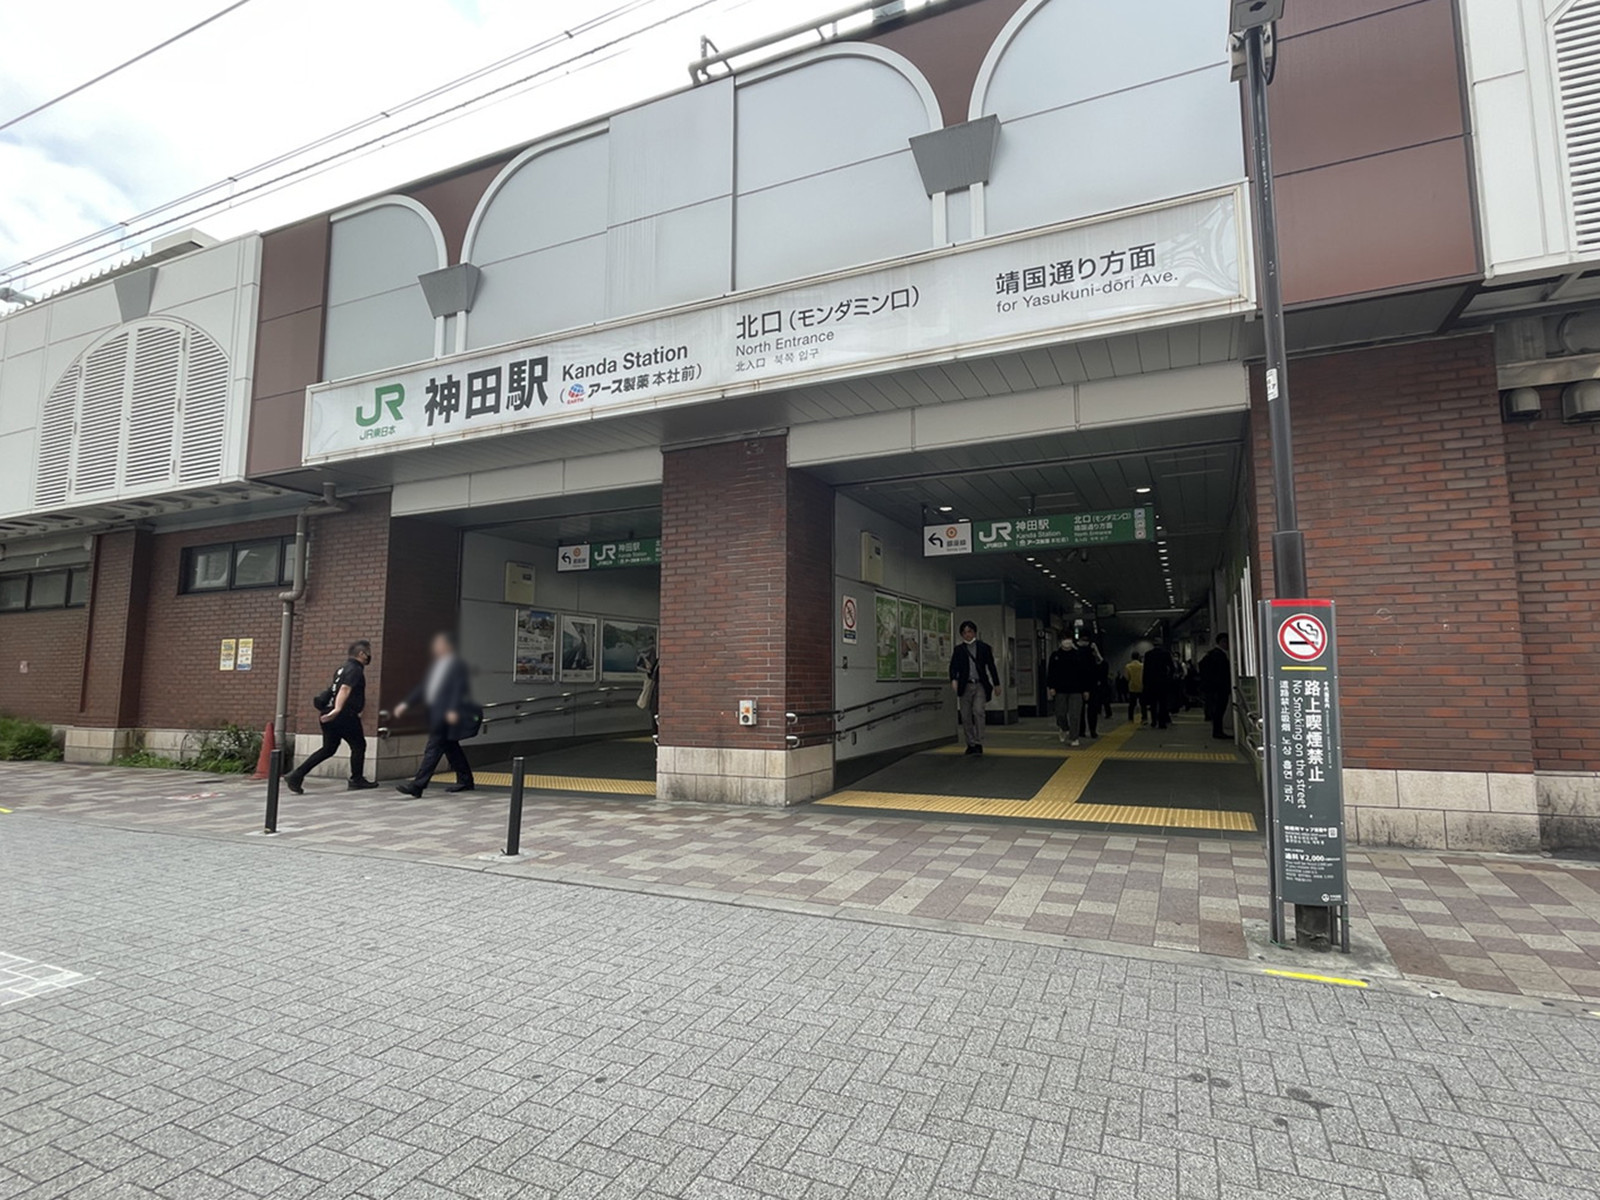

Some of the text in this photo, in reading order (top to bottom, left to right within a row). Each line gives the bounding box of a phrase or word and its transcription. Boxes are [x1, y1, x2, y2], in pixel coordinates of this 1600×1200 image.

[995, 243, 1156, 295] 靖国通り方面
[996, 271, 1178, 313] for Yasukuni-dōri Ave.
[735, 331, 834, 356] North Entrance
[562, 345, 688, 381] Kanda Station
[735, 357, 766, 372] 北入口
[355, 383, 405, 427] JR
[424, 355, 549, 427] 神田駅
[359, 425, 396, 441] JR東日本
[978, 521, 1013, 542] JR
[1015, 518, 1050, 532] 神田駅
[594, 543, 617, 560] JR
[1291, 680, 1307, 809] No Smoking on the street
[1304, 680, 1326, 782] 路上喫煙禁止
